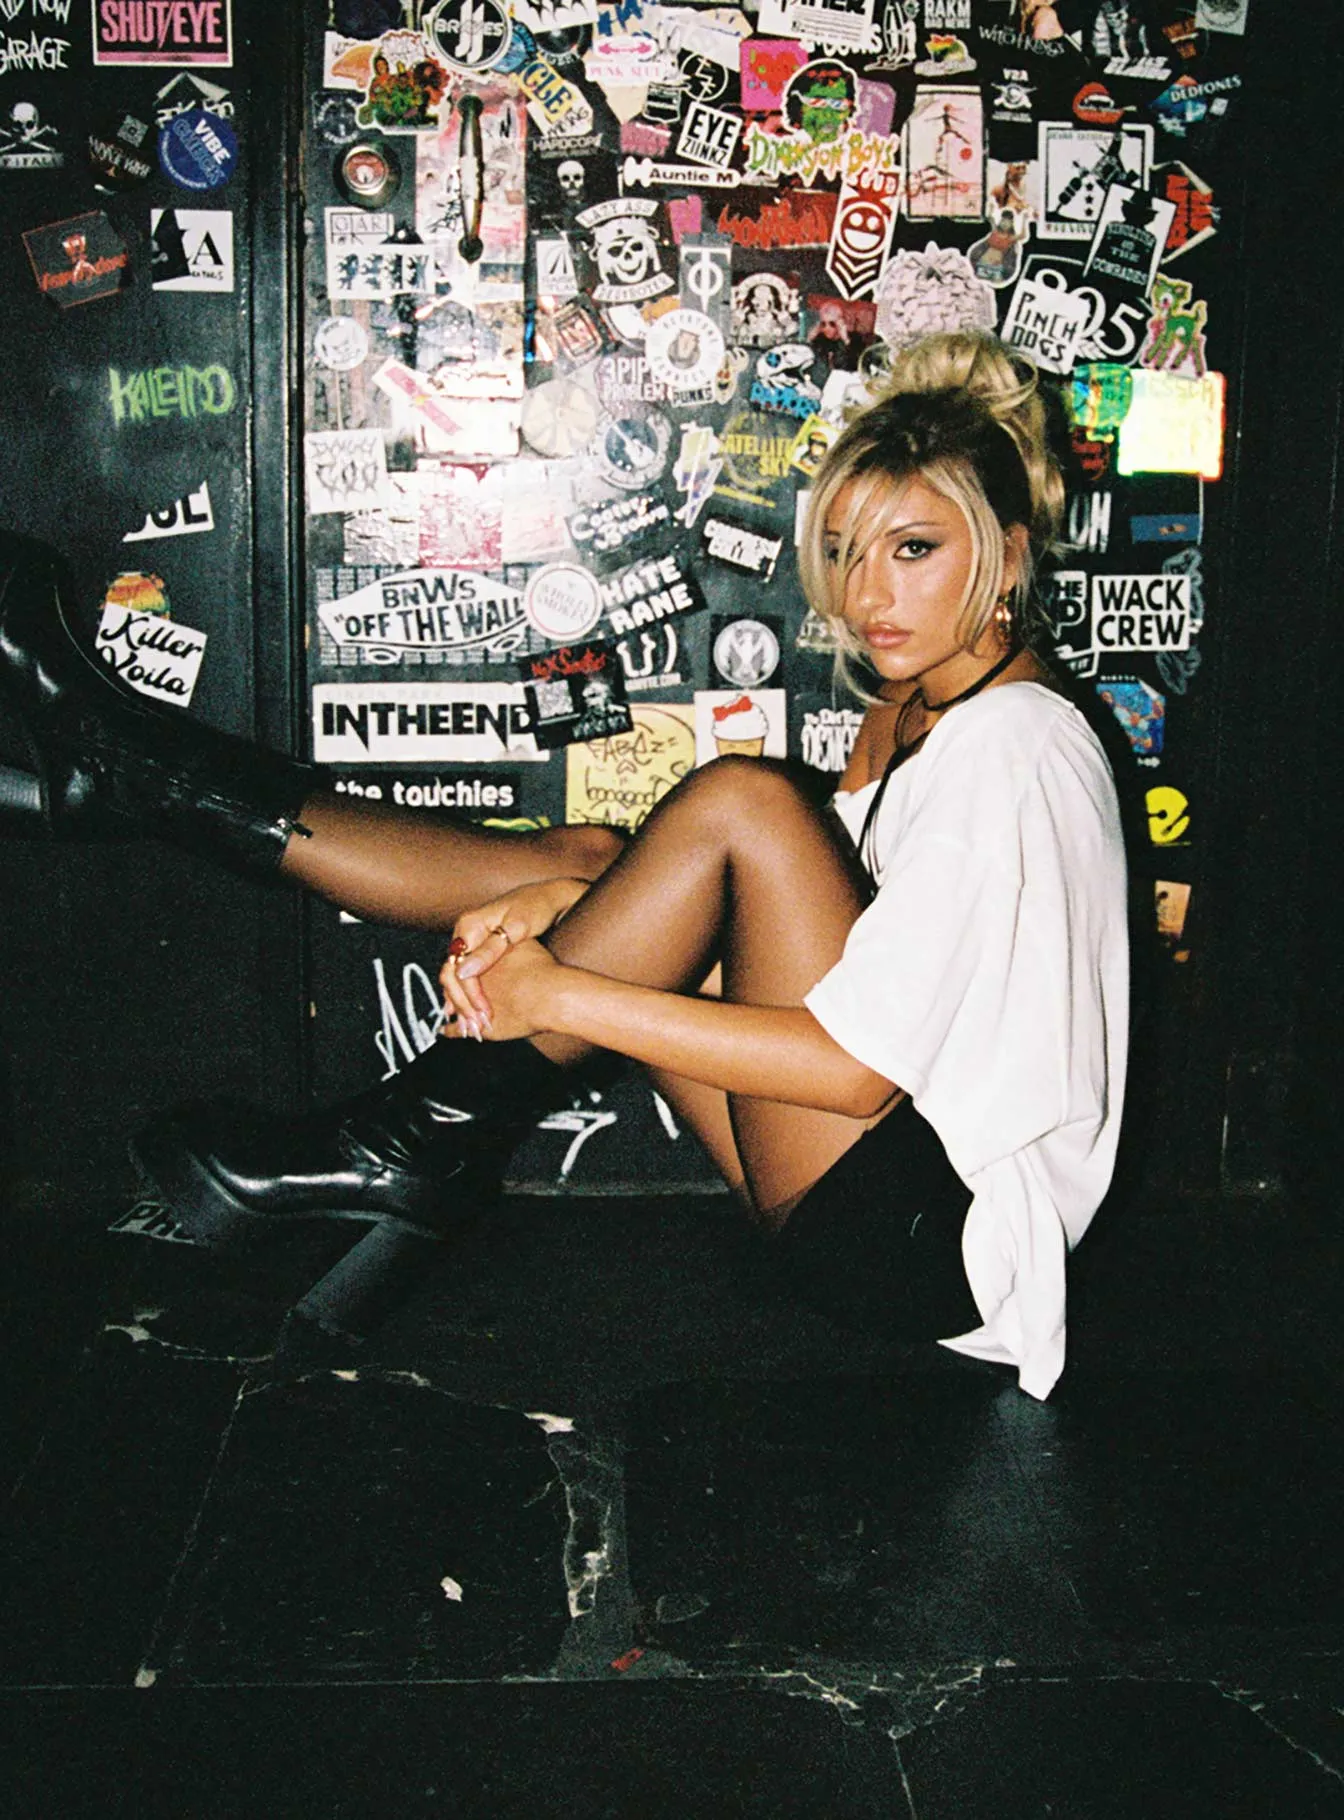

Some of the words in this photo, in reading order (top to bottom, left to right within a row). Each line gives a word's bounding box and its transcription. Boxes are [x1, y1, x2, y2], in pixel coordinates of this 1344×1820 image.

[522, 62, 572, 115] CLE
[194, 117, 232, 166] VIBE
[687, 107, 736, 150] EYE
[649, 167, 710, 183] Auntie
[716, 172, 734, 184] M
[1014, 291, 1079, 343] PINCH
[616, 357, 655, 385] PIP
[108, 364, 237, 428] KALEIDO
[759, 457, 790, 478] SKY
[600, 555, 682, 607] HATE
[1098, 579, 1185, 612] WACK
[100, 612, 203, 660] Killer
[396, 605, 453, 643] THE
[1096, 614, 1186, 647] CREW
[391, 778, 515, 808] touchies
